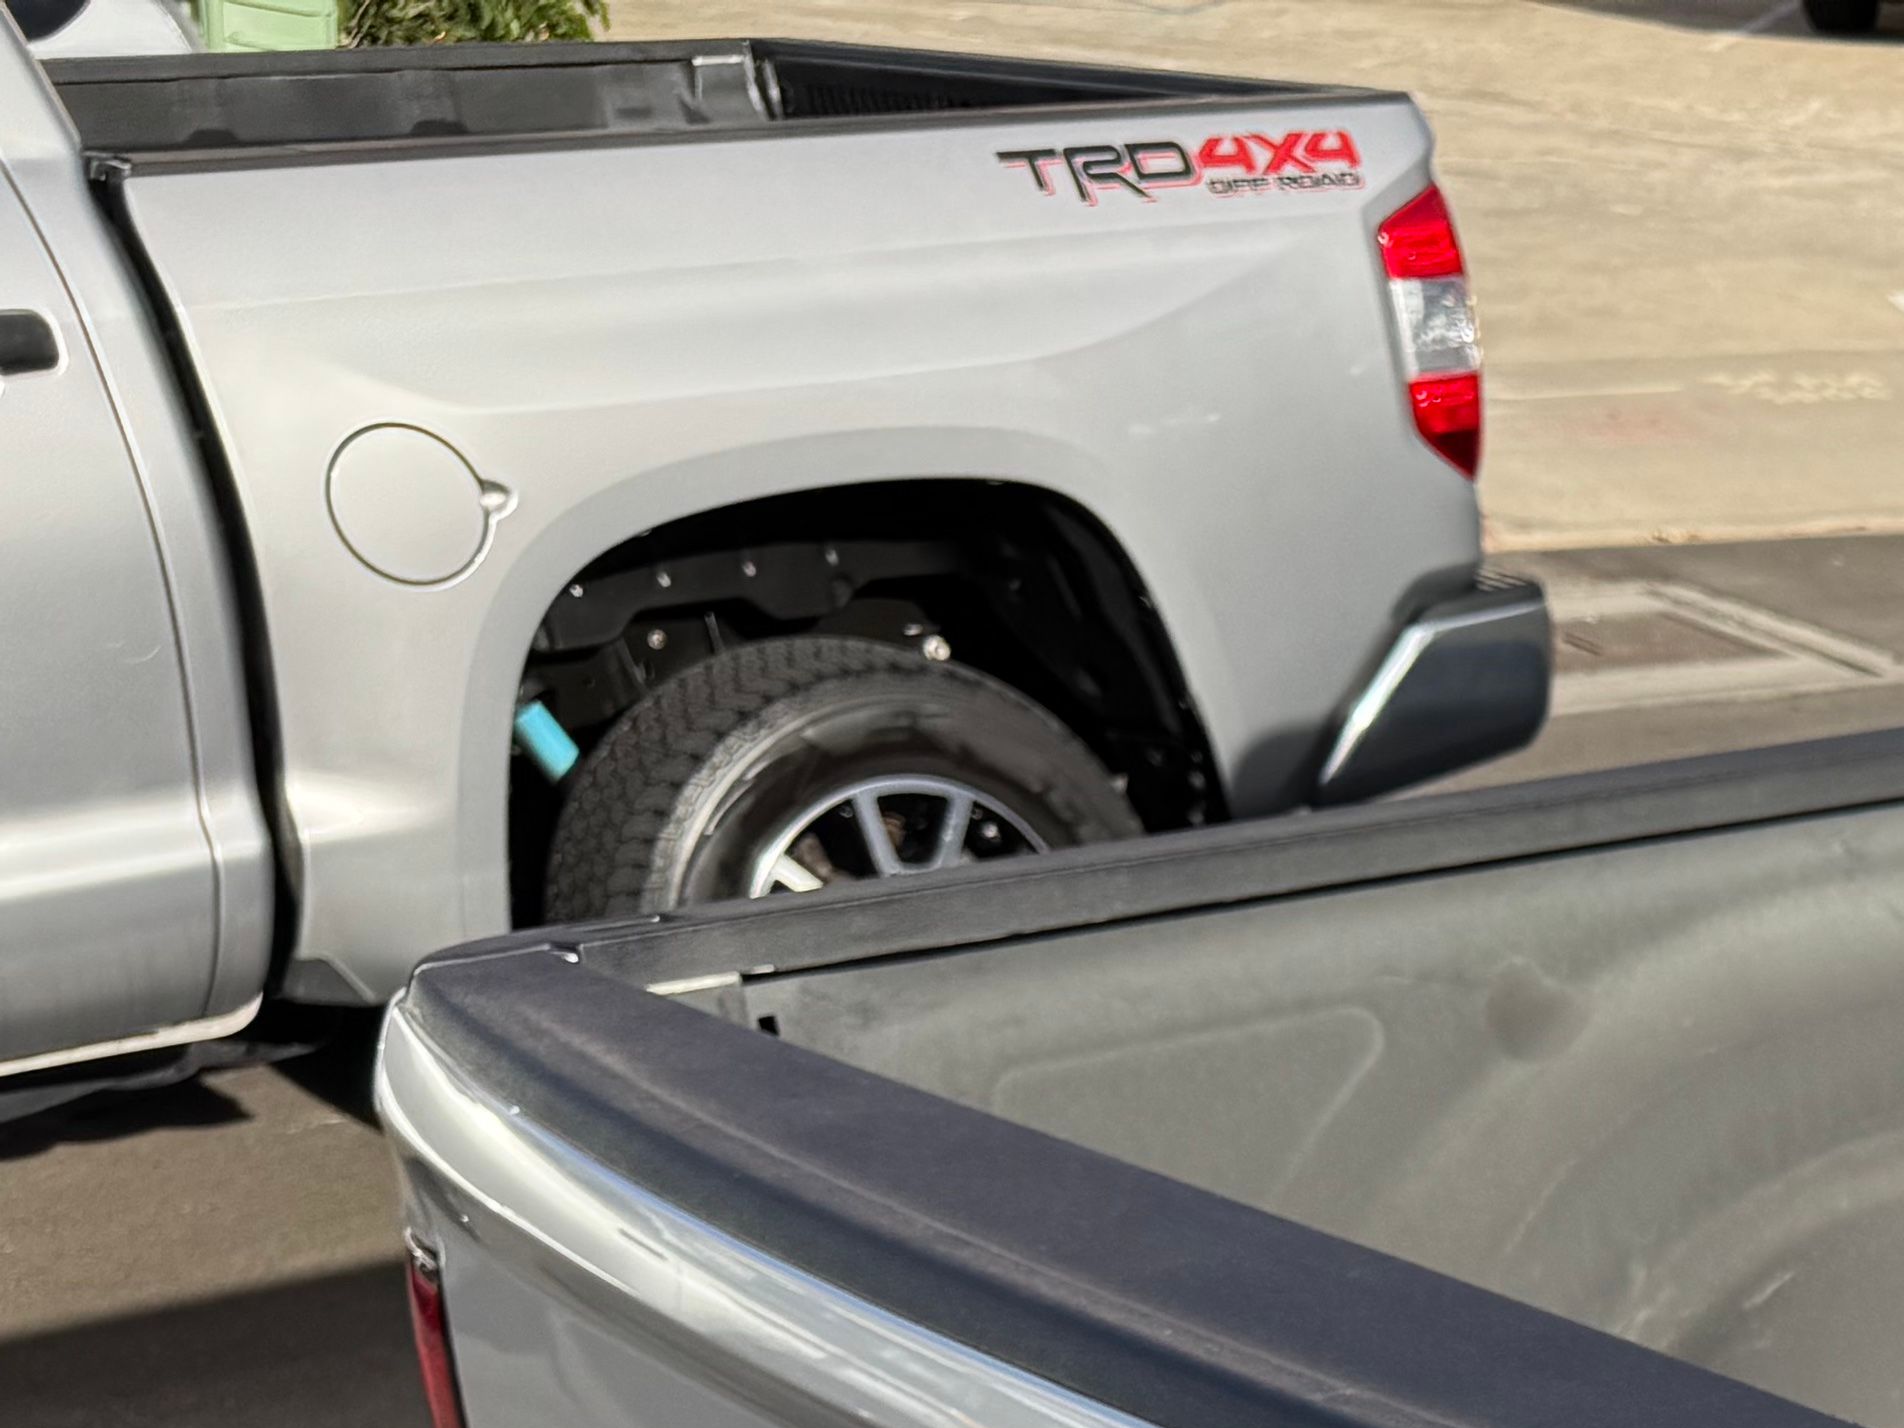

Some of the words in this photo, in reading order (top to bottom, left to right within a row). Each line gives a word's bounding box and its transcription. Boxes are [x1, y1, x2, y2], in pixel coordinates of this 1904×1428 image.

[995, 140, 1201, 205] TRD
[1206, 176, 1271, 197] OFF
[1277, 171, 1364, 192] ROAD
